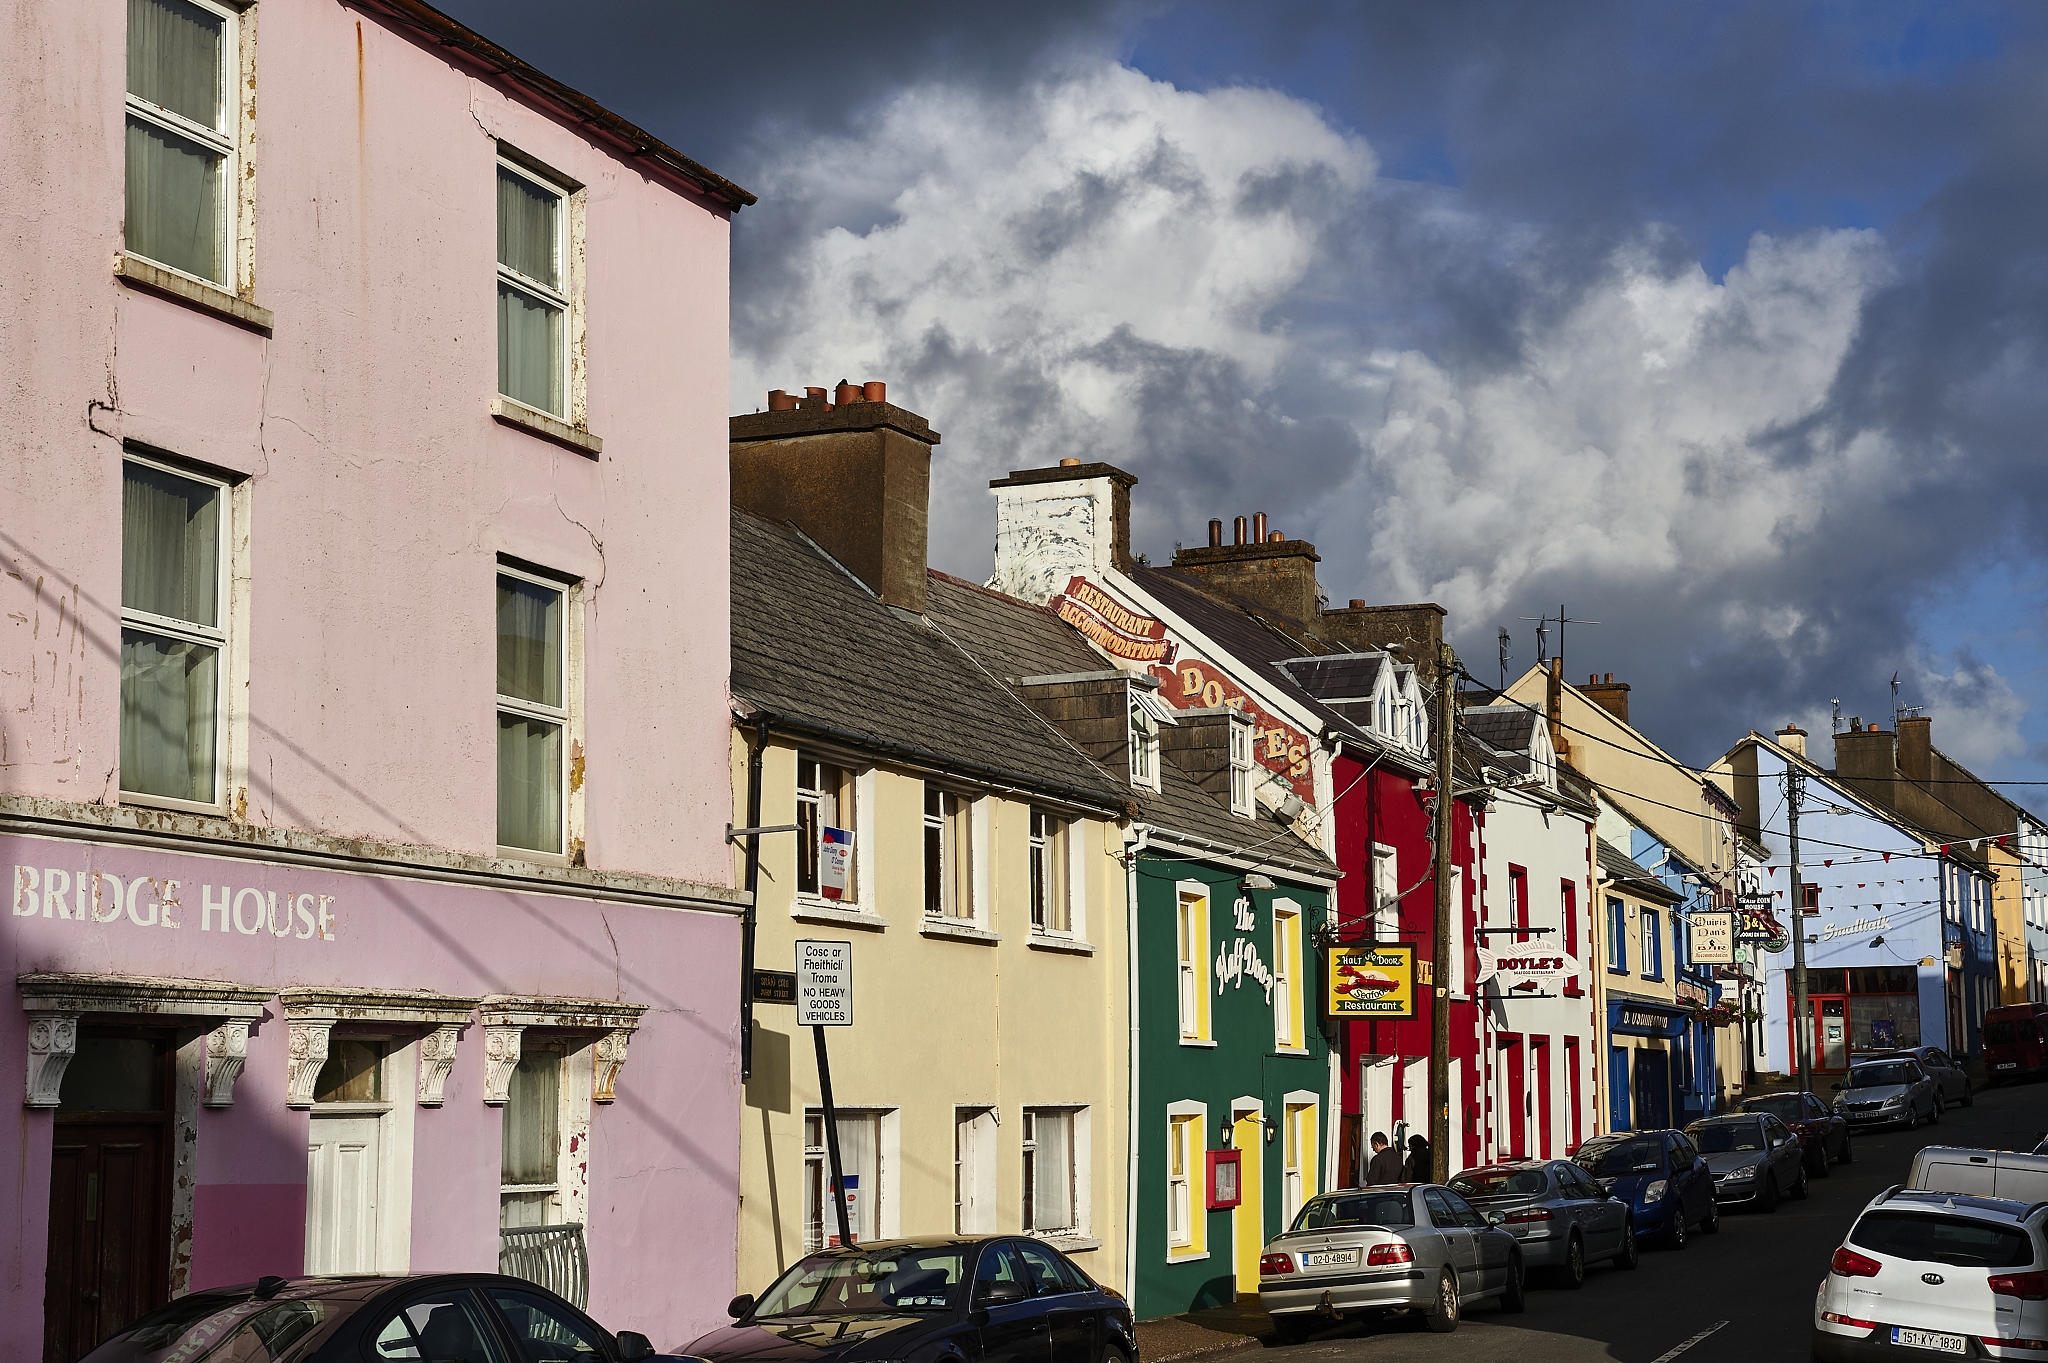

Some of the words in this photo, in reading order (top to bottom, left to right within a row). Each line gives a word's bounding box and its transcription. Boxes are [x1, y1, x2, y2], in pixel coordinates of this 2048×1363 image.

[1077, 583, 1155, 637] RESTAURANT
[1058, 603, 1167, 661] ACCOMMODATION
[12, 864, 183, 929] BRIDGE
[201, 884, 336, 942] HOUSE
[1233, 895, 1256, 932] The
[1697, 928, 1727, 937] Dan's
[1823, 915, 1894, 941] Smalltalk
[805, 945, 829, 957] Cosc
[832, 948, 842, 957] ar
[803, 958, 844, 971] Fheithiclí
[1496, 957, 1564, 970] DOYLE'S
[811, 972, 838, 984] Troma
[1215, 937, 1246, 996] Half
[1243, 941, 1274, 1006] Door
[803, 987, 816, 997] NO
[819, 988, 846, 998] HEAVY
[809, 1000, 841, 1009] GOODS
[1344, 1001, 1397, 1011] Restaurant
[805, 1011, 846, 1021] VEHICLES
[1924, 1274, 1942, 1284] KIA
[1902, 1331, 1962, 1350] 151-KY-1830
